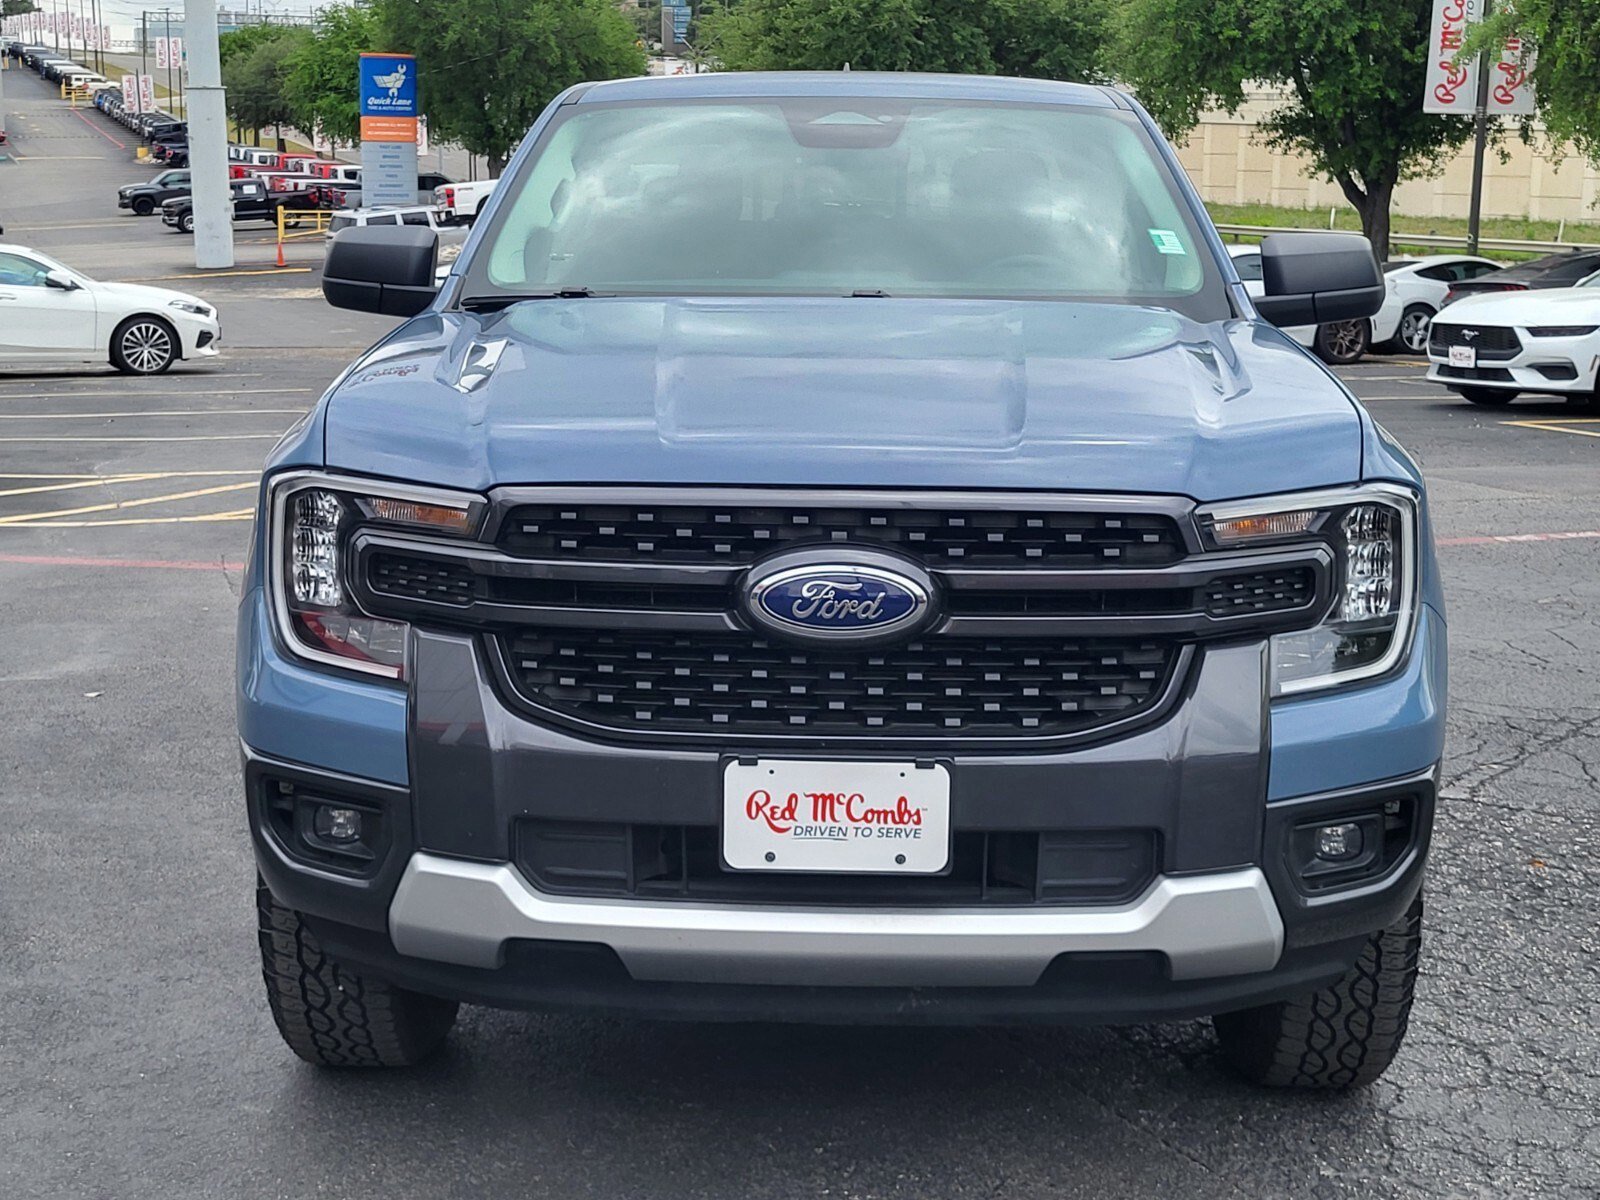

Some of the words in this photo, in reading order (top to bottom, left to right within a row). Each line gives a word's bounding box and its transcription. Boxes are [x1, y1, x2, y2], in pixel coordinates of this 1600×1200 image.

[367, 96, 392, 106] Quick
[391, 97, 413, 106] Lane
[1434, 61, 1467, 104] Red
[1494, 62, 1525, 105] Red
[792, 580, 886, 620] Ford
[746, 790, 798, 834] Red
[803, 792, 923, 826] McCombs
[793, 825, 849, 838] DRIVEN
[853, 826, 873, 838] TO
[877, 826, 922, 839] SERVE
